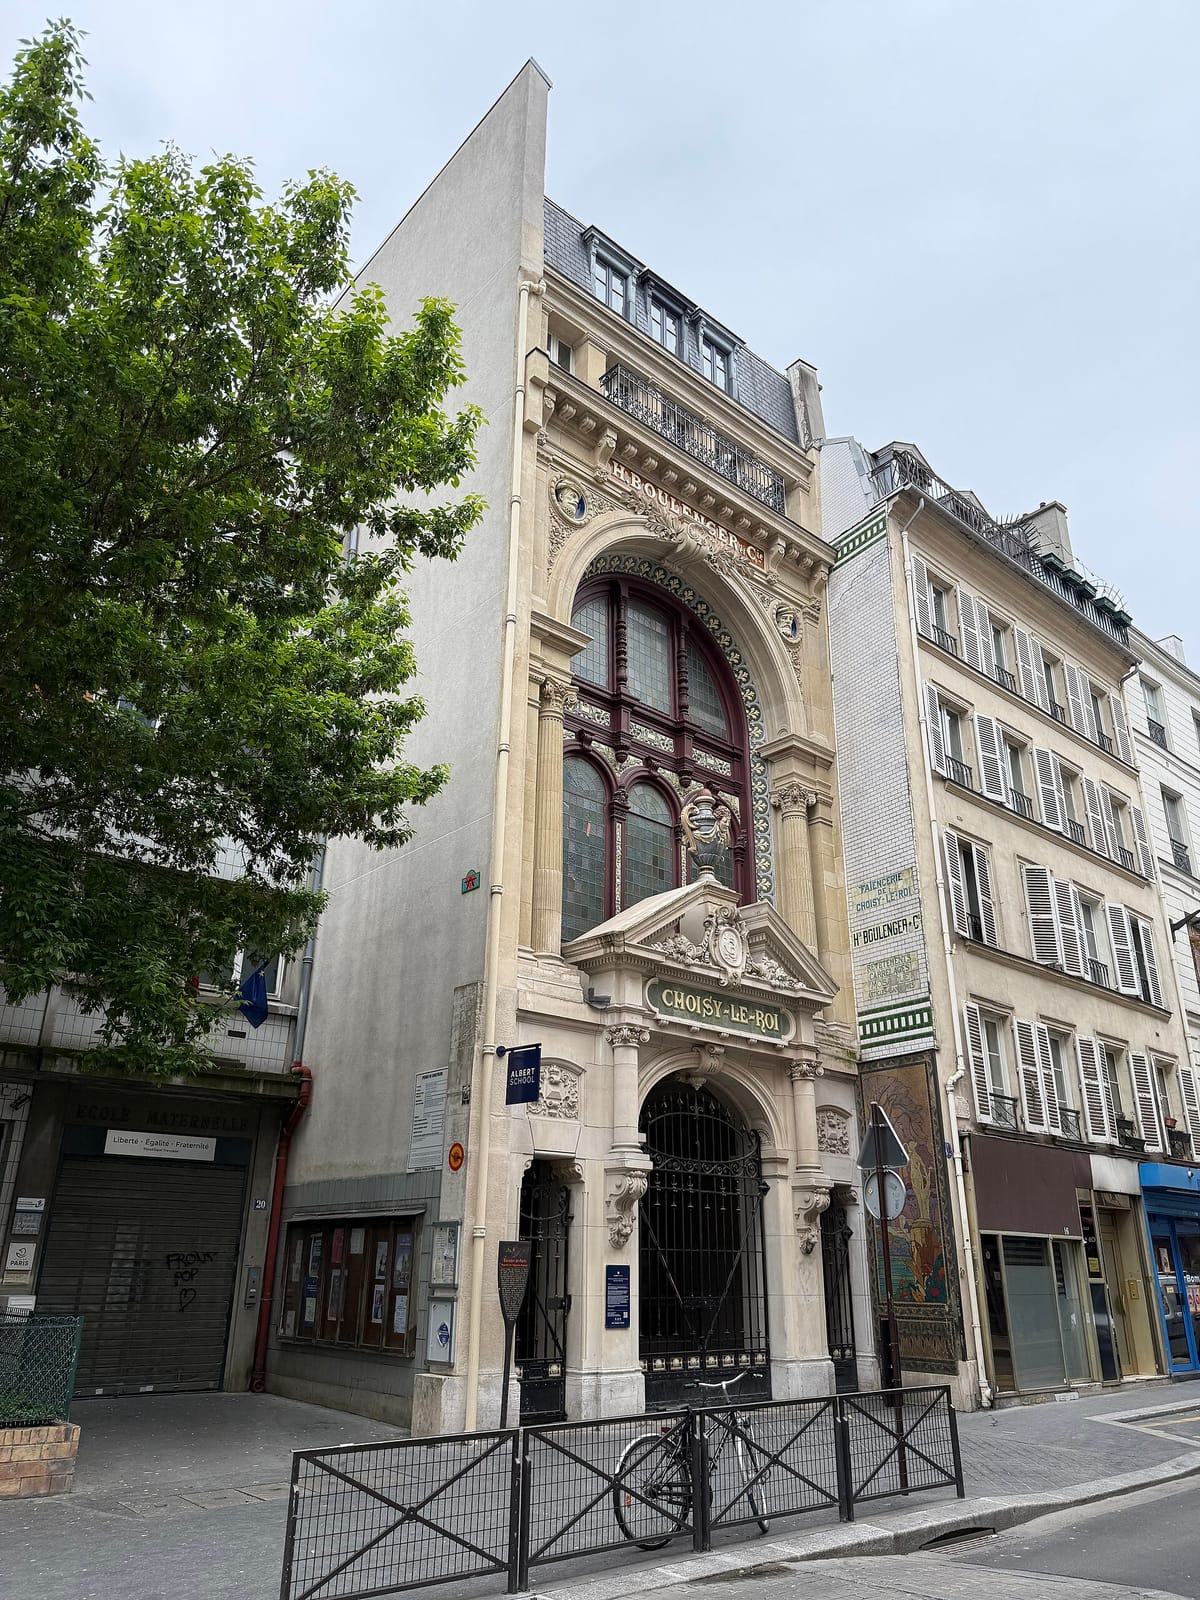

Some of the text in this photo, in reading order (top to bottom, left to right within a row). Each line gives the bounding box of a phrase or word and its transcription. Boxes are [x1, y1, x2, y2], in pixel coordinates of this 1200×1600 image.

[878, 888, 886, 896] DE
[863, 918, 908, 945] BOULENGER
[661, 989, 780, 1033] CHOISY-LE-ROI
[510, 1067, 535, 1078] ALBERT
[510, 1076, 535, 1086] SCHOOL
[76, 1104, 249, 1131] ECOLE MATERNELLE
[113, 1135, 139, 1145] Liberté
[175, 1140, 210, 1151] Fraternité
[255, 1200, 266, 1209] 20
